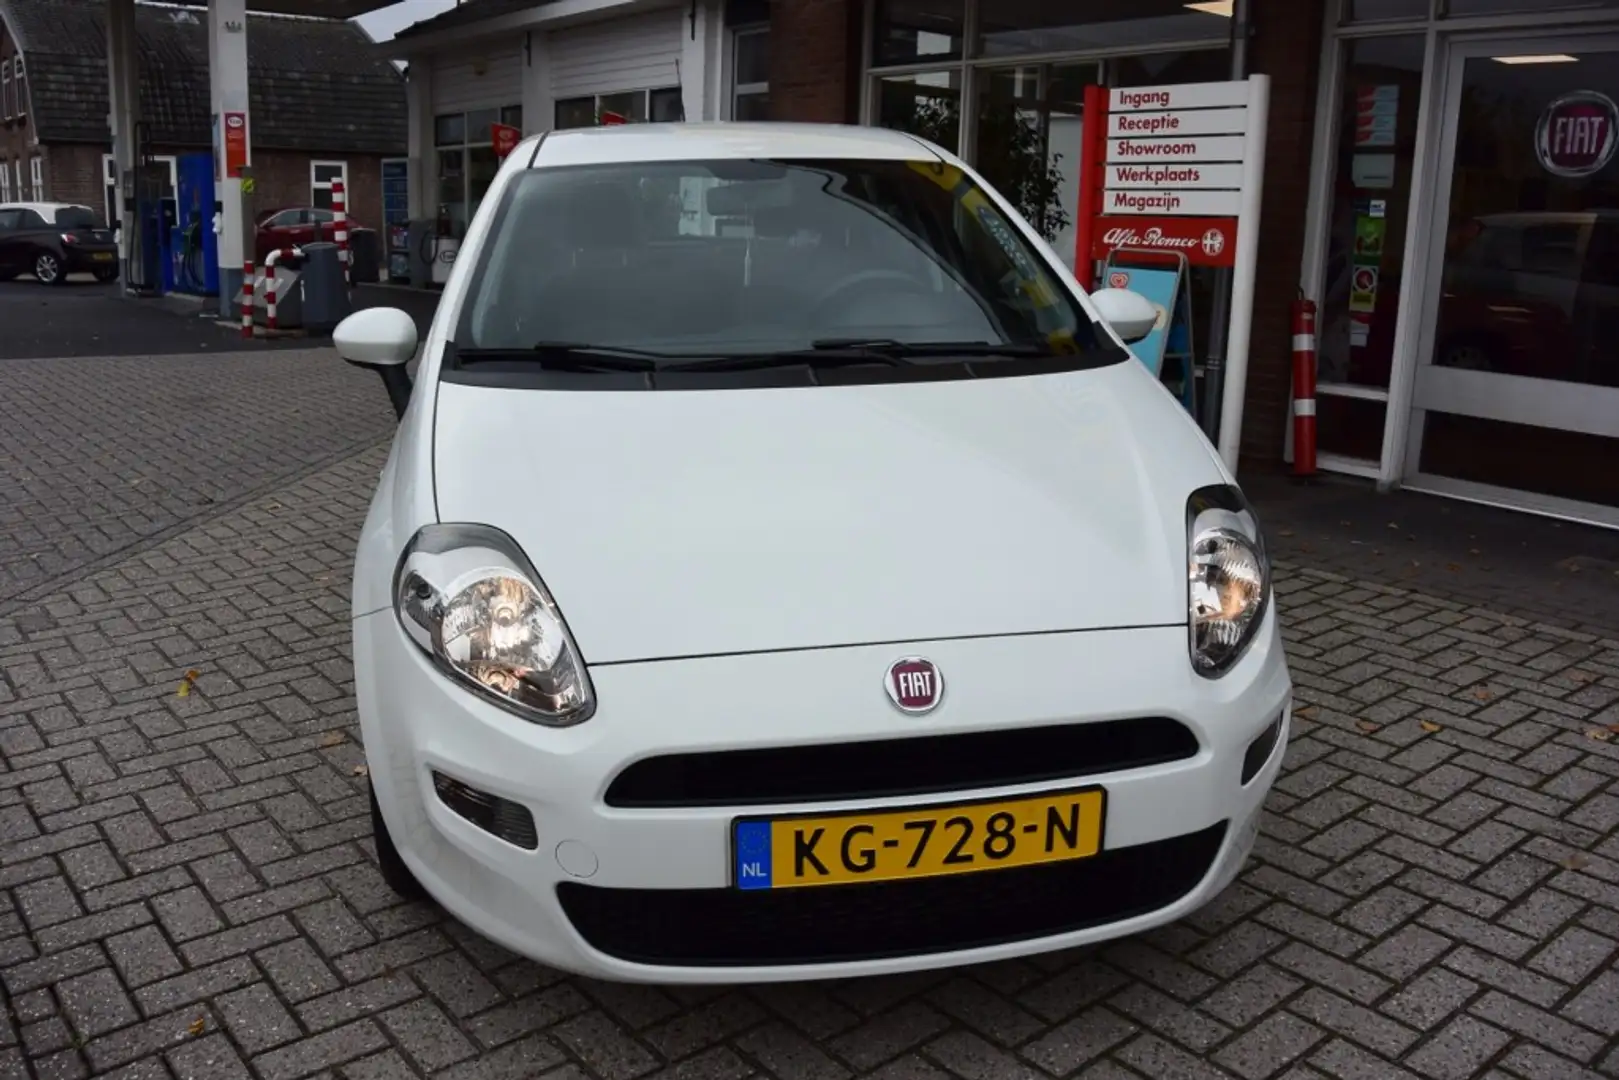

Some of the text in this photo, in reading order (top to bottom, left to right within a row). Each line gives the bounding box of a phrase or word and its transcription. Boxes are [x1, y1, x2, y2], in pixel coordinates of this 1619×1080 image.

[1119, 91, 1170, 108] Ingang
[1118, 114, 1179, 133] Receptie
[1554, 116, 1604, 154] FIAT
[1117, 140, 1196, 156] Showroom
[1116, 166, 1200, 185] Werkplaats
[1114, 192, 1180, 211] Magazijn
[1103, 227, 1199, 249] Alfa Romeo
[899, 671, 932, 698] FIAT
[742, 803, 1080, 877] NL KG-728-N
